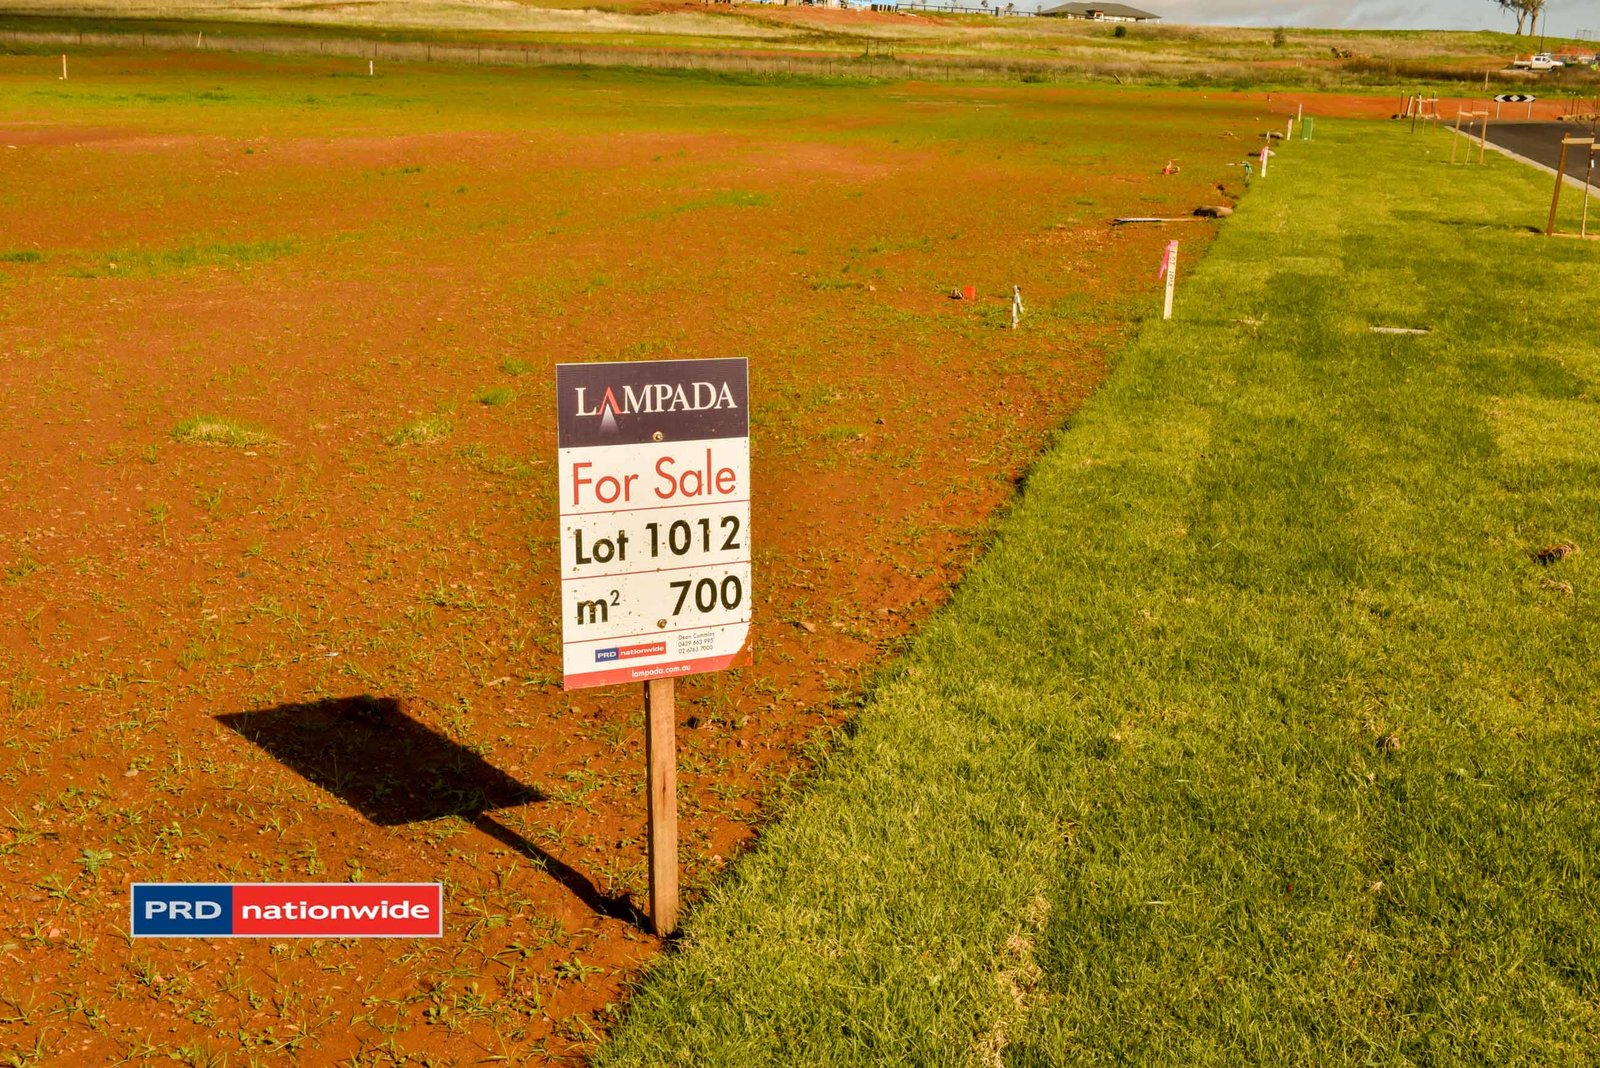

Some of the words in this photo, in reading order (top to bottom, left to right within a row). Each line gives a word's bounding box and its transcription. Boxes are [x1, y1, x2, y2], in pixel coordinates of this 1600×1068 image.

[575, 381, 738, 416] LAMPADA
[572, 462, 639, 505] For
[654, 448, 736, 499] Sale
[574, 529, 629, 565] Lot
[645, 515, 740, 558] 1012
[670, 575, 742, 616] 700
[597, 651, 617, 659] PRD
[620, 646, 665, 656] nationwide
[631, 665, 691, 678] lampada.com.au
